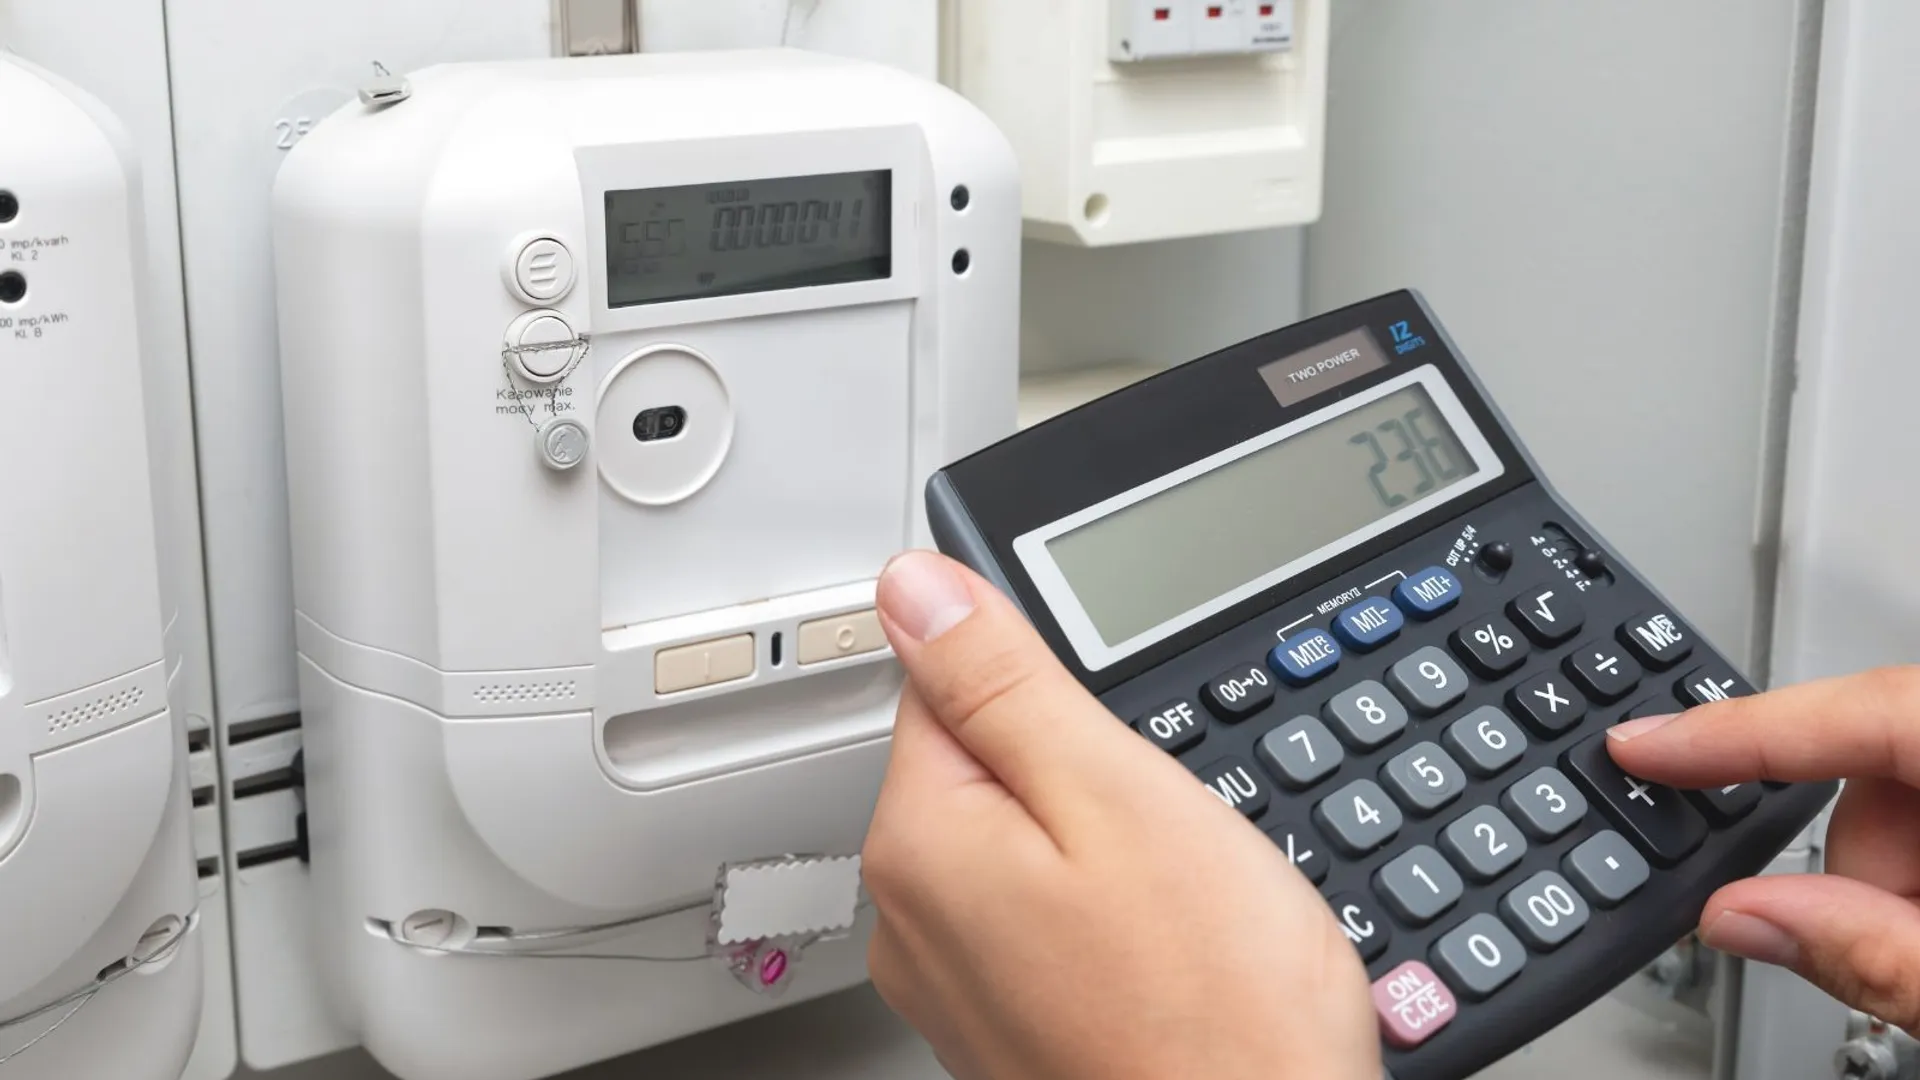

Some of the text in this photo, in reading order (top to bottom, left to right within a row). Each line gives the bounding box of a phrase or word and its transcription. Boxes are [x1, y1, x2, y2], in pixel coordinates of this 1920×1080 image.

[11, 251, 38, 261] KL 2
[15, 330, 27, 339] KL
[19, 313, 68, 327] imp/kWh
[1288, 348, 1360, 383] TWO POWER
[1347, 407, 1463, 507] 236
[1446, 524, 1477, 567] CUT UP 5/4
[1474, 623, 1514, 655] %
[1418, 661, 1448, 690] 9
[1149, 702, 1195, 739] OFF
[1355, 695, 1387, 725] 8
[1288, 729, 1316, 763] 7
[1477, 720, 1507, 750] 6
[1411, 756, 1445, 788] 5
[1353, 795, 1382, 825] 4
[1535, 783, 1567, 814] 3
[1474, 822, 1509, 856] 2
[1411, 864, 1440, 894] 1
[1526, 884, 1576, 928] 00
[1467, 933, 1501, 968] 0
[1387, 969, 1422, 1000] ON
